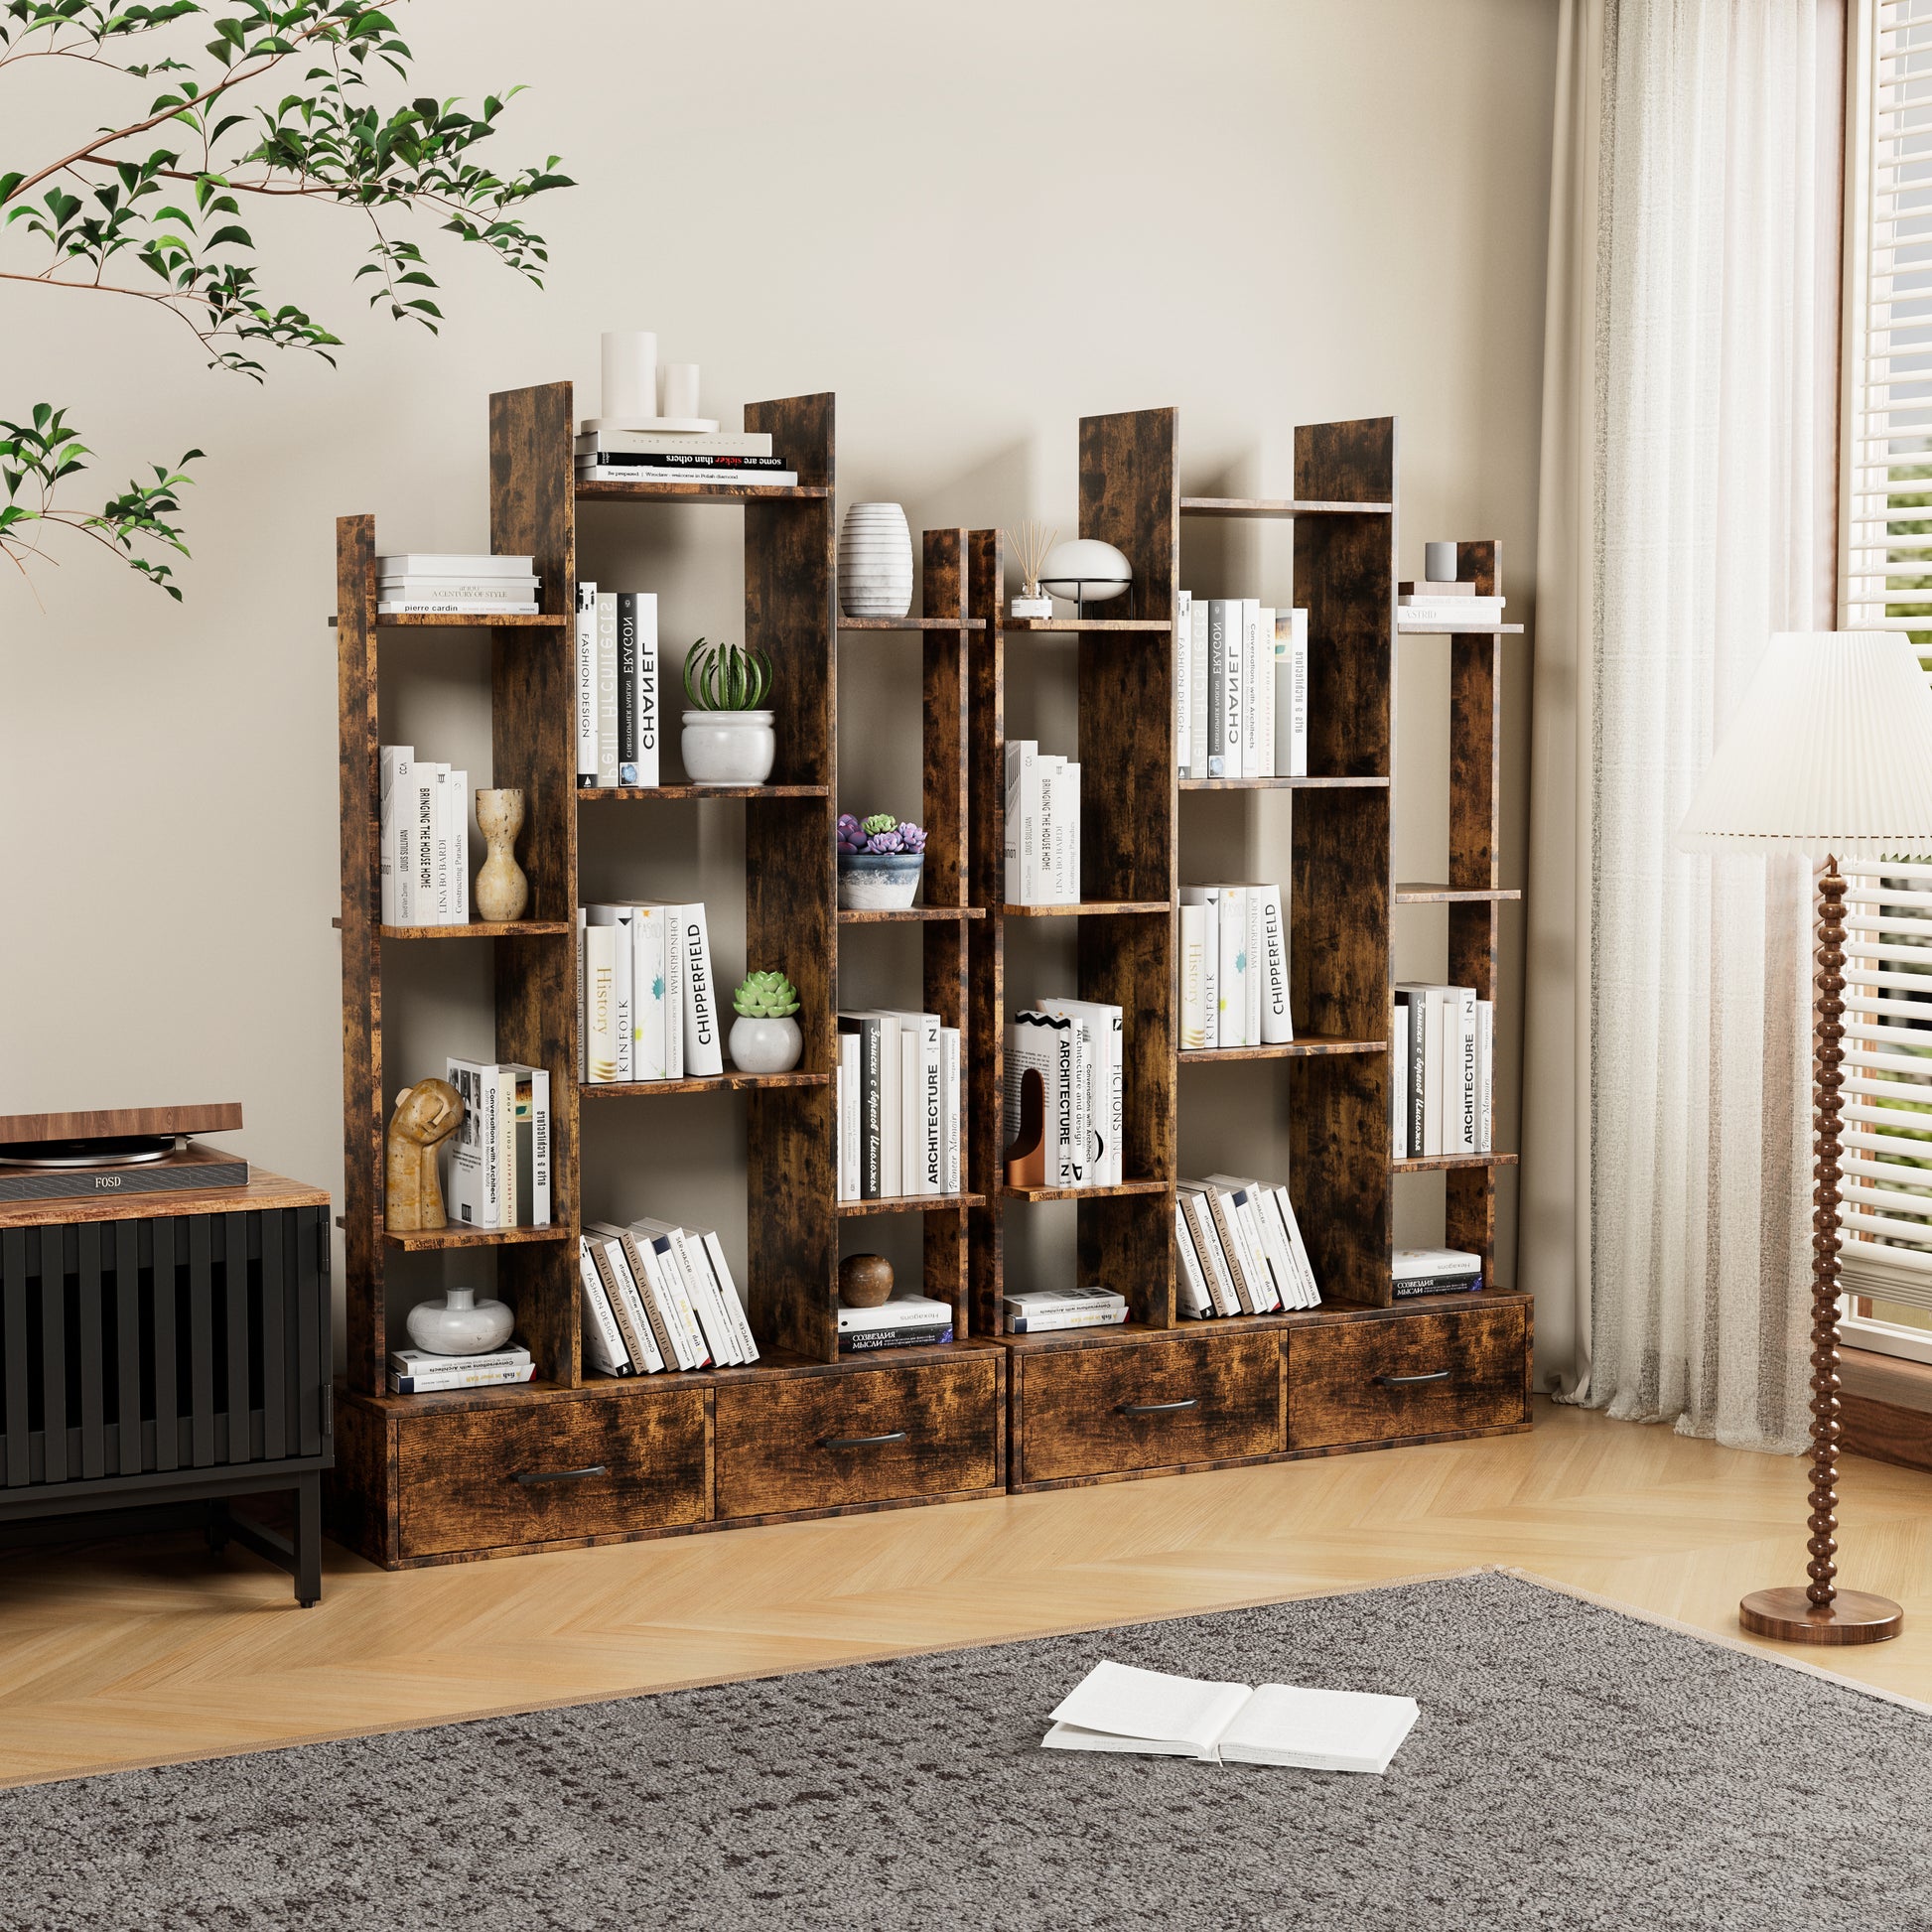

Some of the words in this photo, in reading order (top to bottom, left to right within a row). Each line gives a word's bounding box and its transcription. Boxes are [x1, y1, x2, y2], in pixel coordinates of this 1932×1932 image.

[399, 762, 408, 774] CCA
[420, 787, 430, 823] BRINGING
[400, 829, 409, 855] SULLIVAN
[420, 826, 430, 839] THE
[400, 856, 409, 872] LOUIS
[421, 842, 431, 866] HOUSE
[1056, 857, 1062, 869] BO
[421, 868, 431, 889] HOME
[439, 874, 447, 887] BO
[1185, 944, 1201, 1007] History
[1266, 904, 1284, 1015] CHIPPERFIELD
[593, 967, 612, 1035] History
[687, 924, 711, 1044] CHIPPERFIELD
[619, 1001, 628, 1072] KINFOLK
[1416, 1000, 1425, 1043] Записки
[870, 1028, 880, 1074] Записки
[1060, 1040, 1069, 1145] ARCHITECTURE
[1414, 1057, 1425, 1094] берегов
[1464, 1034, 1473, 1145] ARCHITECTURE
[868, 1090, 880, 1131] берегов
[1112, 1065, 1121, 1131] FICTIONS
[928, 1065, 938, 1184] ARCHITECTURE
[949, 1112, 958, 1153] Memoirs
[1415, 1098, 1424, 1151] Имоложья
[1481, 1117, 1490, 1150] Pioneer
[870, 1135, 880, 1192] Имоложья
[1112, 1136, 1121, 1166] INC.
[94, 1176, 121, 1188] FOSD
[1176, 1222, 1192, 1258] FASHION
[1187, 1258, 1200, 1288] DESIGN
[1208, 1186, 1224, 1226] PATRICK
[1218, 1226, 1248, 1300] DEMARCHELIER
[623, 1233, 641, 1275] PATRICK
[638, 1276, 671, 1355] DEMARCHELIER
[1397, 1279, 1434, 1289] СОЗВЕЗДИЯ
[587, 1273, 604, 1311] FASHION
[600, 1311, 616, 1343] DESIGN
[852, 1331, 896, 1341] СОЗВЕЗДИЯ
[853, 1340, 883, 1349] МЫСЛИ
